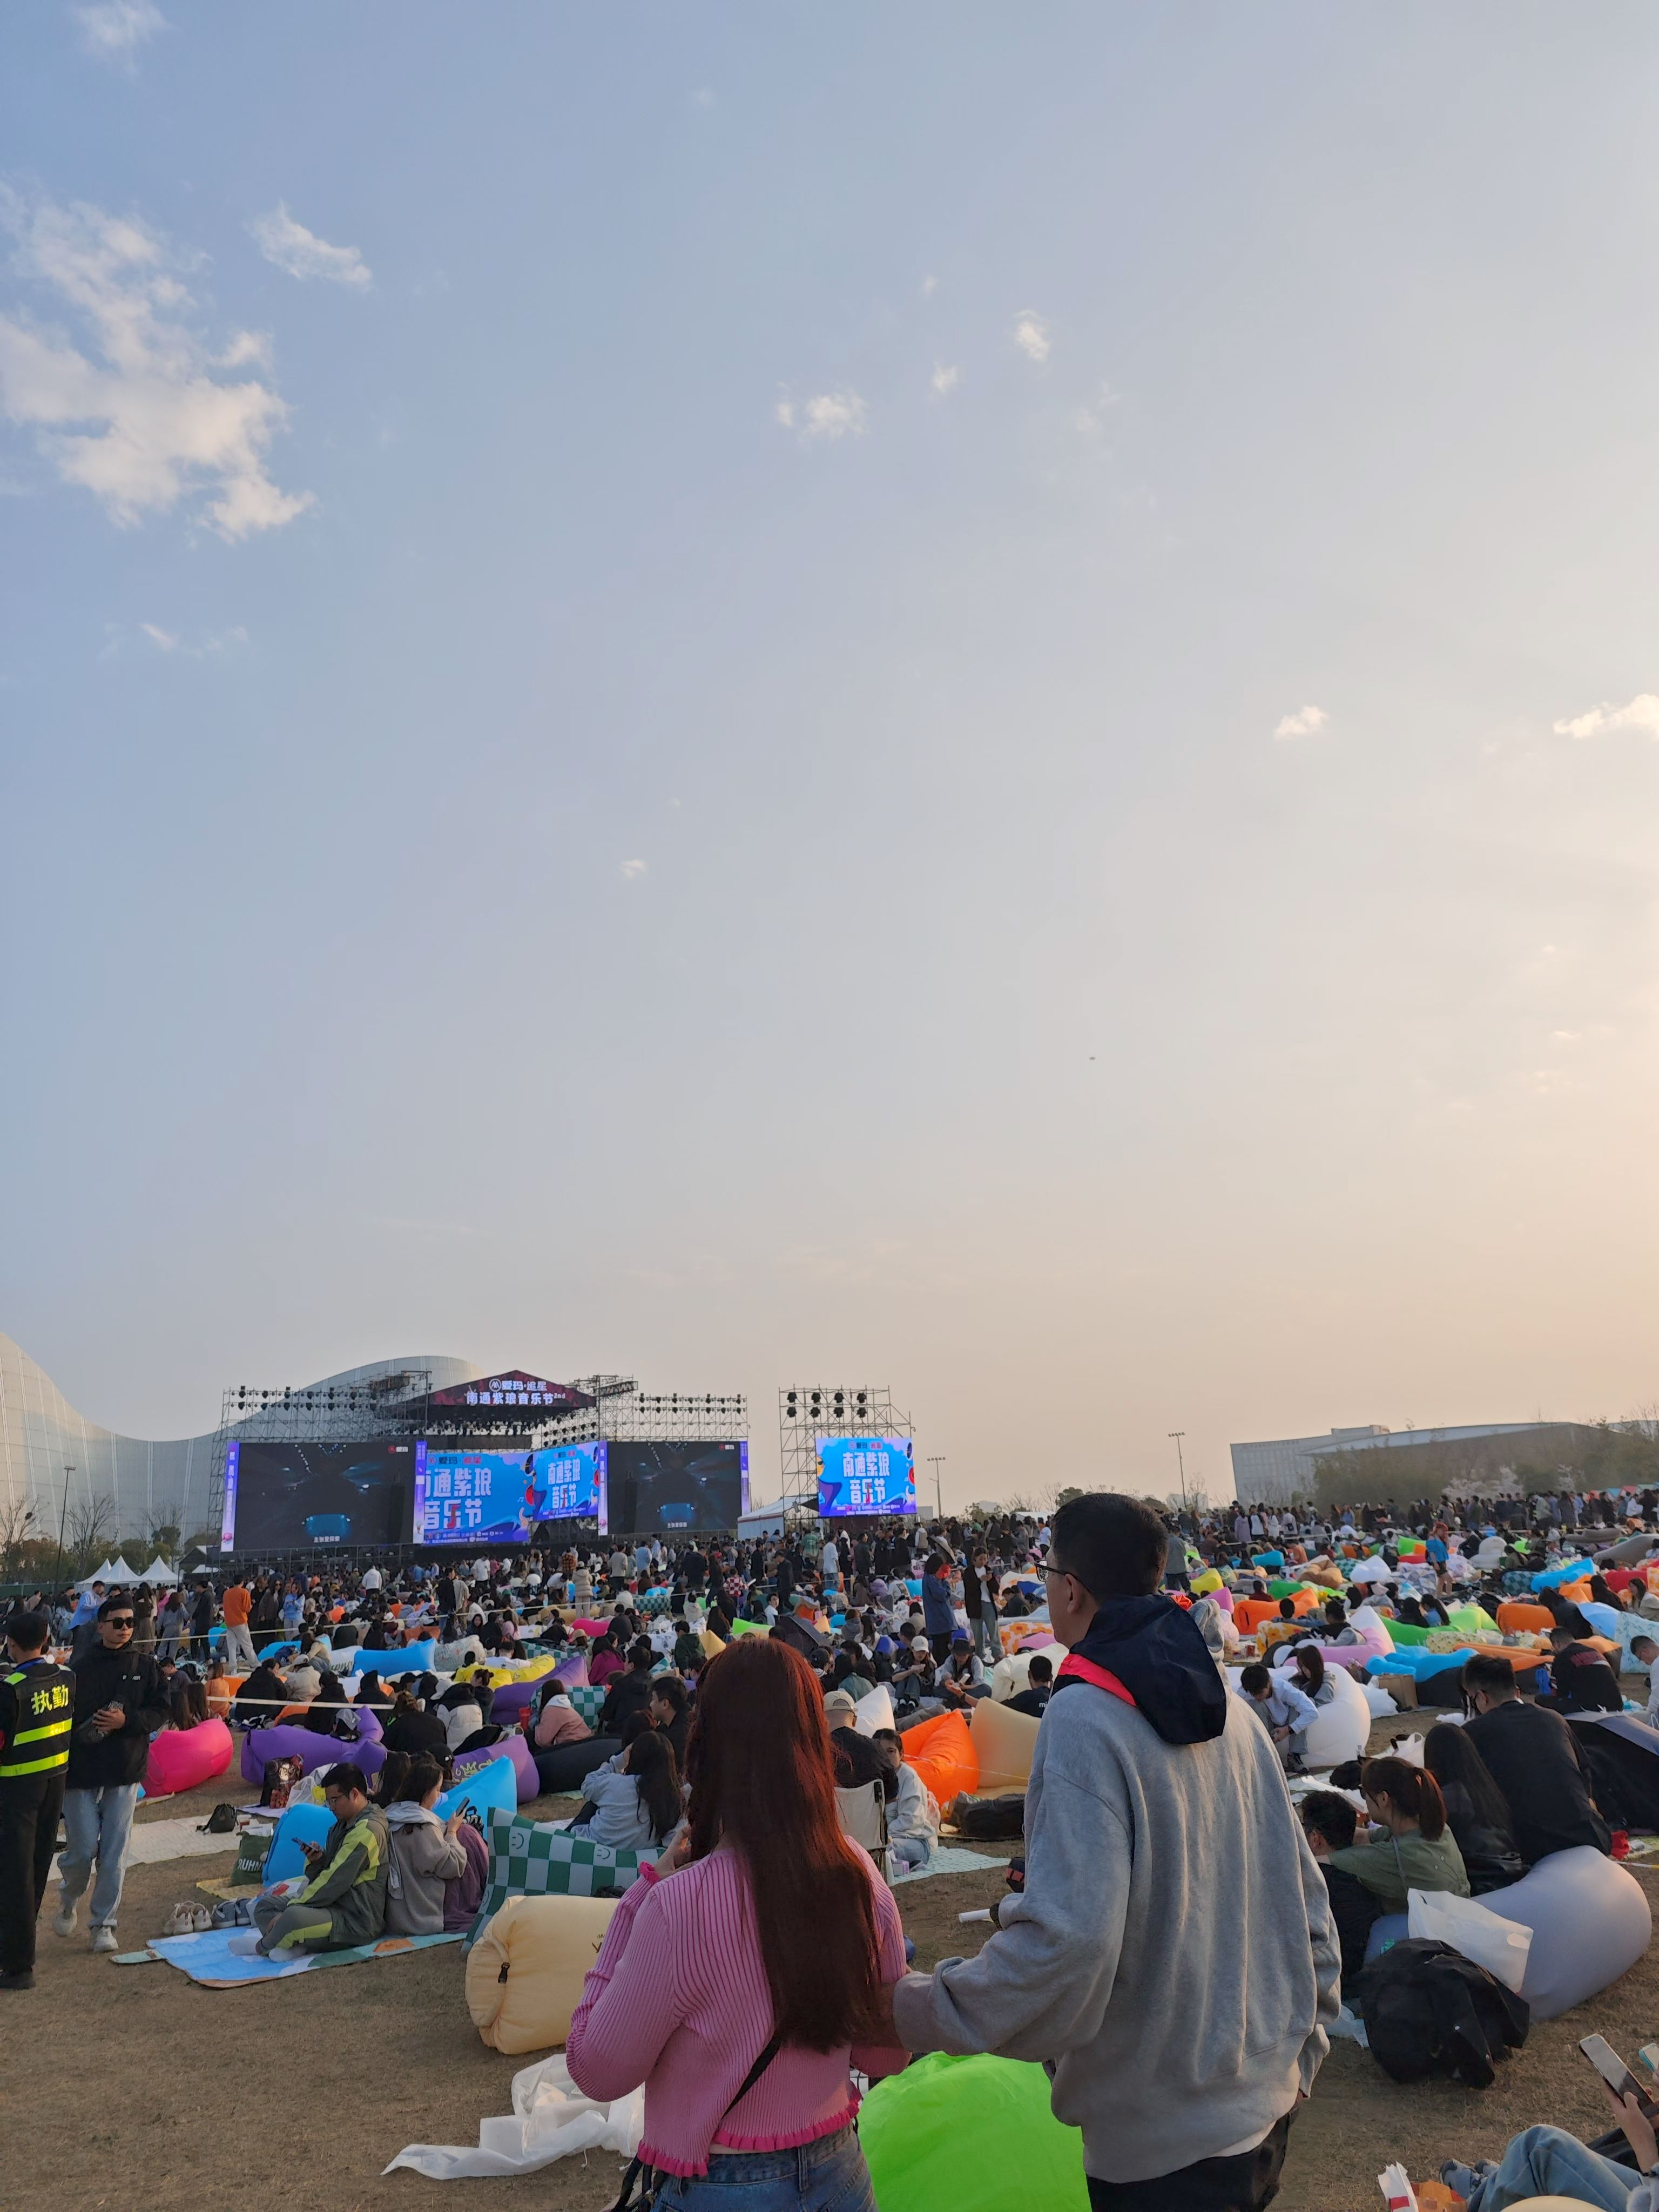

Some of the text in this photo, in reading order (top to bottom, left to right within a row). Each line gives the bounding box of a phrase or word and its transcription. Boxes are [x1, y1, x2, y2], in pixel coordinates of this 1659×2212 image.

[552, 1483, 576, 1508] 音乐节
[849, 1478, 886, 1504] 音乐节
[424, 1499, 482, 1529] 音乐节
[31, 1684, 69, 1715] 执勤
